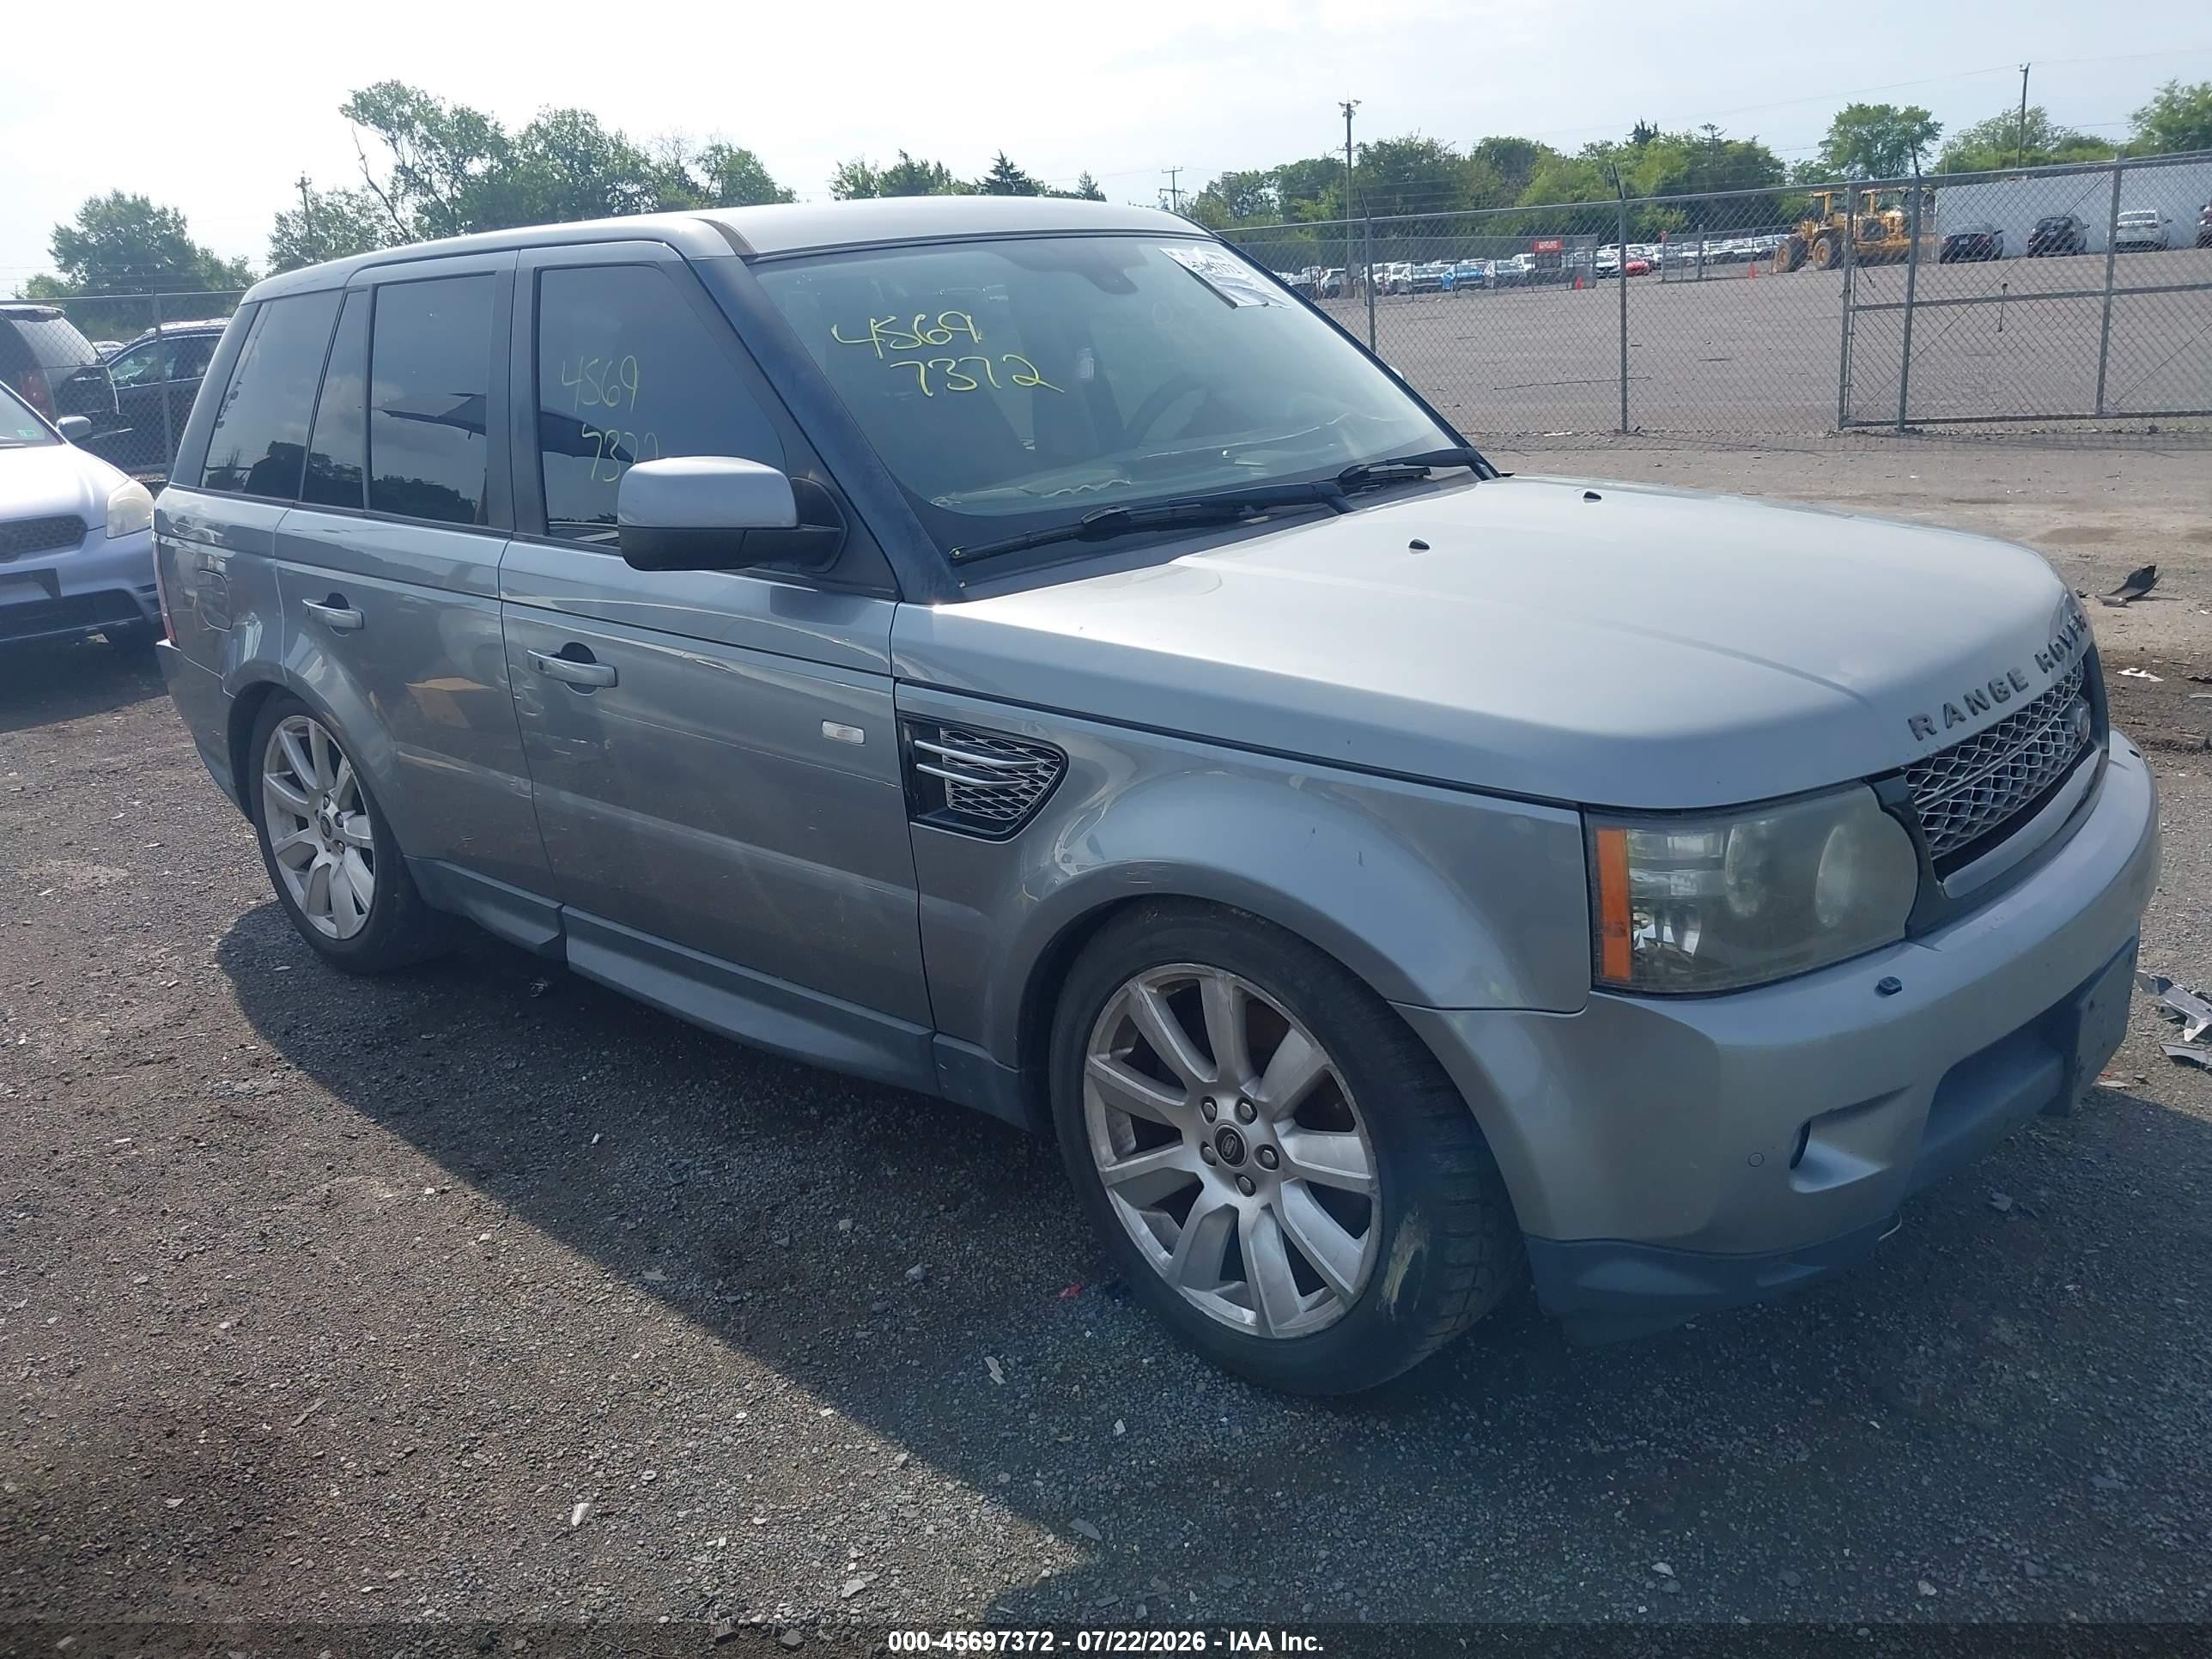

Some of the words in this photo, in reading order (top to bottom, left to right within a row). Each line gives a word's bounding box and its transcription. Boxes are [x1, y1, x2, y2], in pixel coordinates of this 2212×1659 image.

[830, 311, 982, 359] 4569
[562, 356, 640, 412] 4569
[890, 354, 1065, 397] 7372
[1907, 667, 2030, 742] RANGE
[2033, 610, 2087, 674] ROVER
